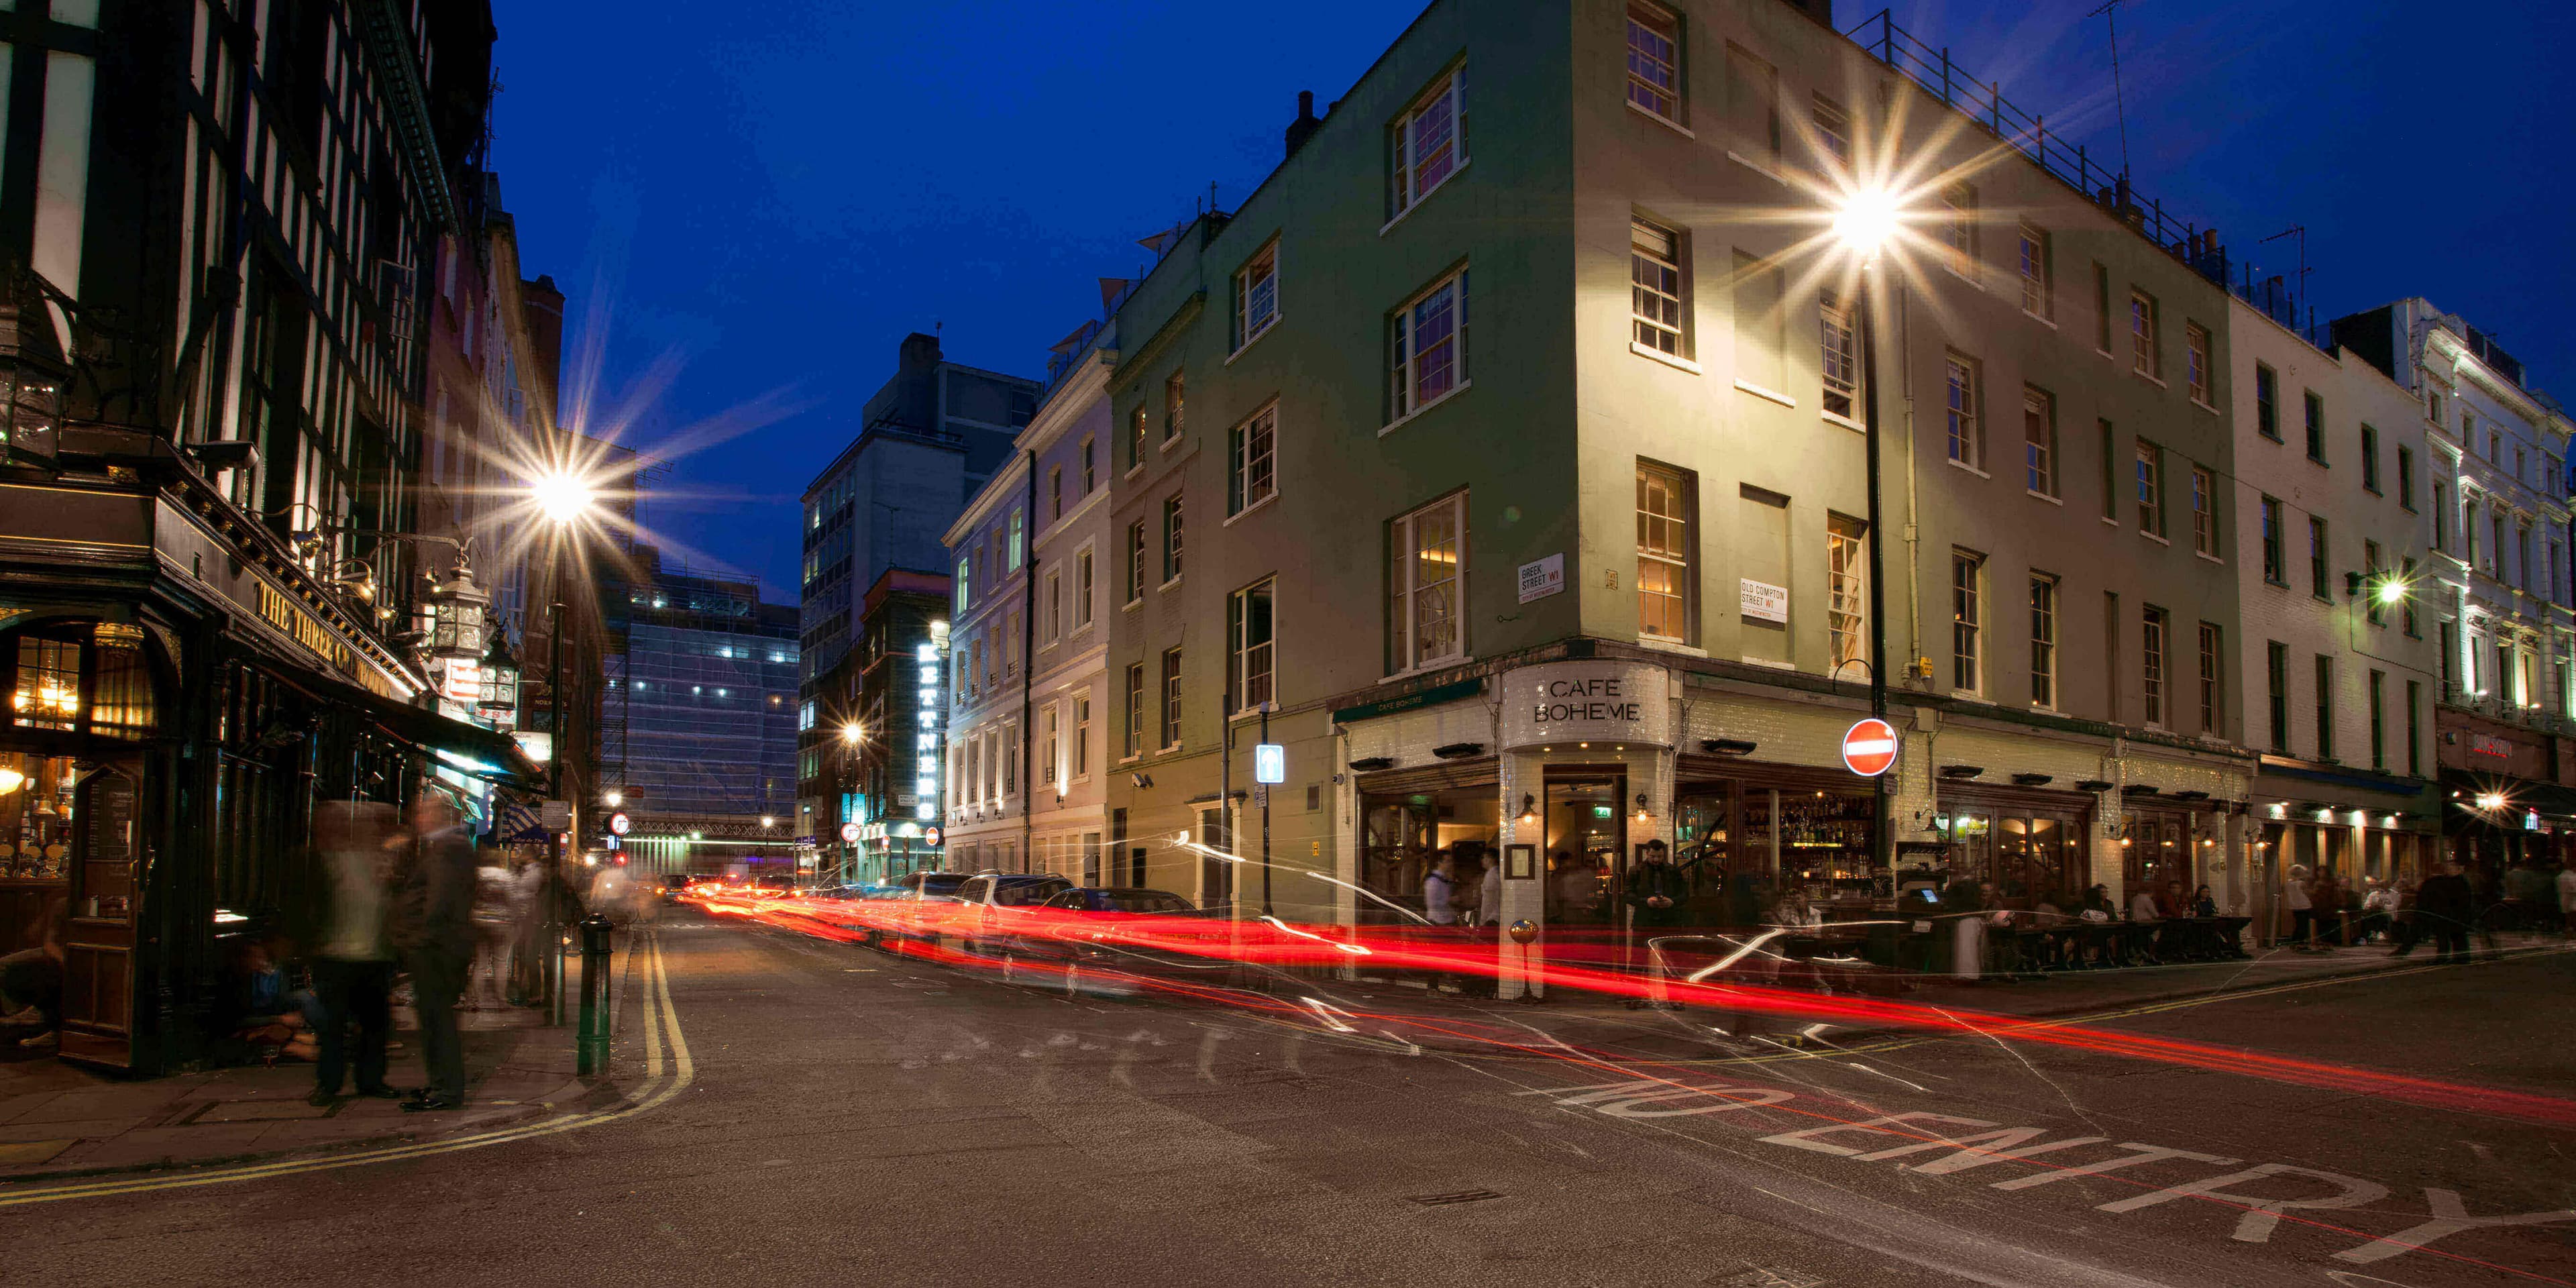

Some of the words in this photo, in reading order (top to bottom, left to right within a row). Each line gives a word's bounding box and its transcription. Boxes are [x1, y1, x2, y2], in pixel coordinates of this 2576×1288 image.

[1522, 564, 1542, 579] GREEK
[1522, 574, 1546, 590] STREET
[1742, 582, 1754, 593] OLD
[1756, 586, 1784, 600] COMPTON
[1741, 594, 1764, 606] STREET
[1765, 598, 1774, 608] W1
[259, 581, 289, 631] THE
[292, 608, 333, 662] THREE
[1550, 680, 1621, 698] CAFE
[1379, 702, 1394, 711] CAFE
[1395, 696, 1423, 708] BOHEME
[1534, 703, 1640, 723] BOHEME
[918, 645, 939, 818] KETTNERS
[1507, 1077, 1796, 1118] NO
[1754, 1111, 2576, 1265] ENTRY
